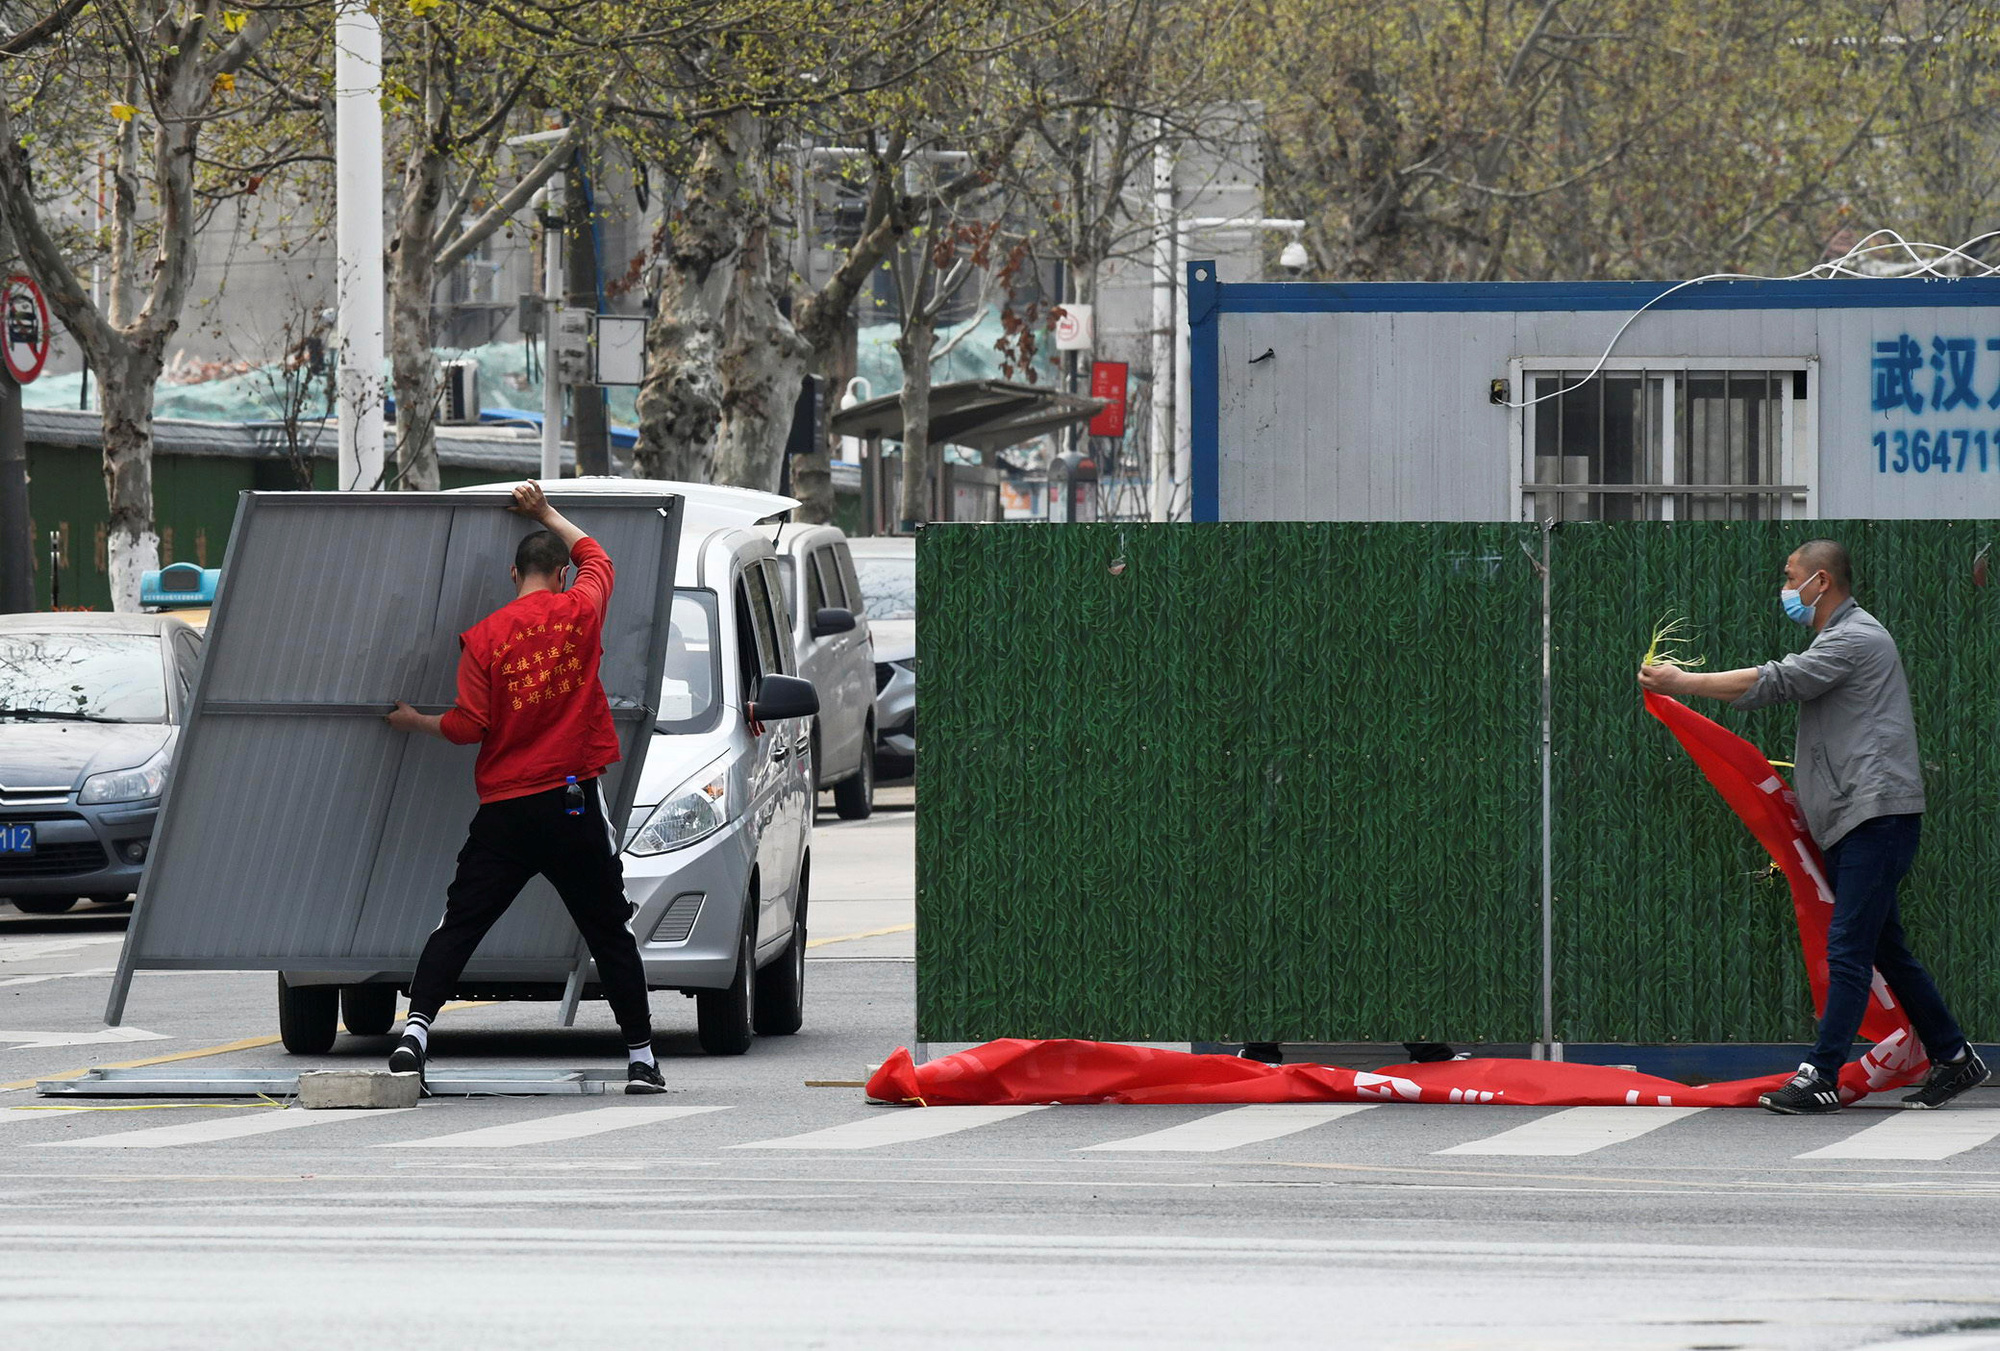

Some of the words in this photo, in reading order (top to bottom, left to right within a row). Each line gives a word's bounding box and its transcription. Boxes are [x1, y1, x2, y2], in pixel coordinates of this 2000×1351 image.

[1872, 334, 2000, 415] 武汉
[501, 640, 576, 676] 迎接军运会
[507, 656, 582, 692] 打造新环境
[512, 676, 585, 711] 当好东道主
